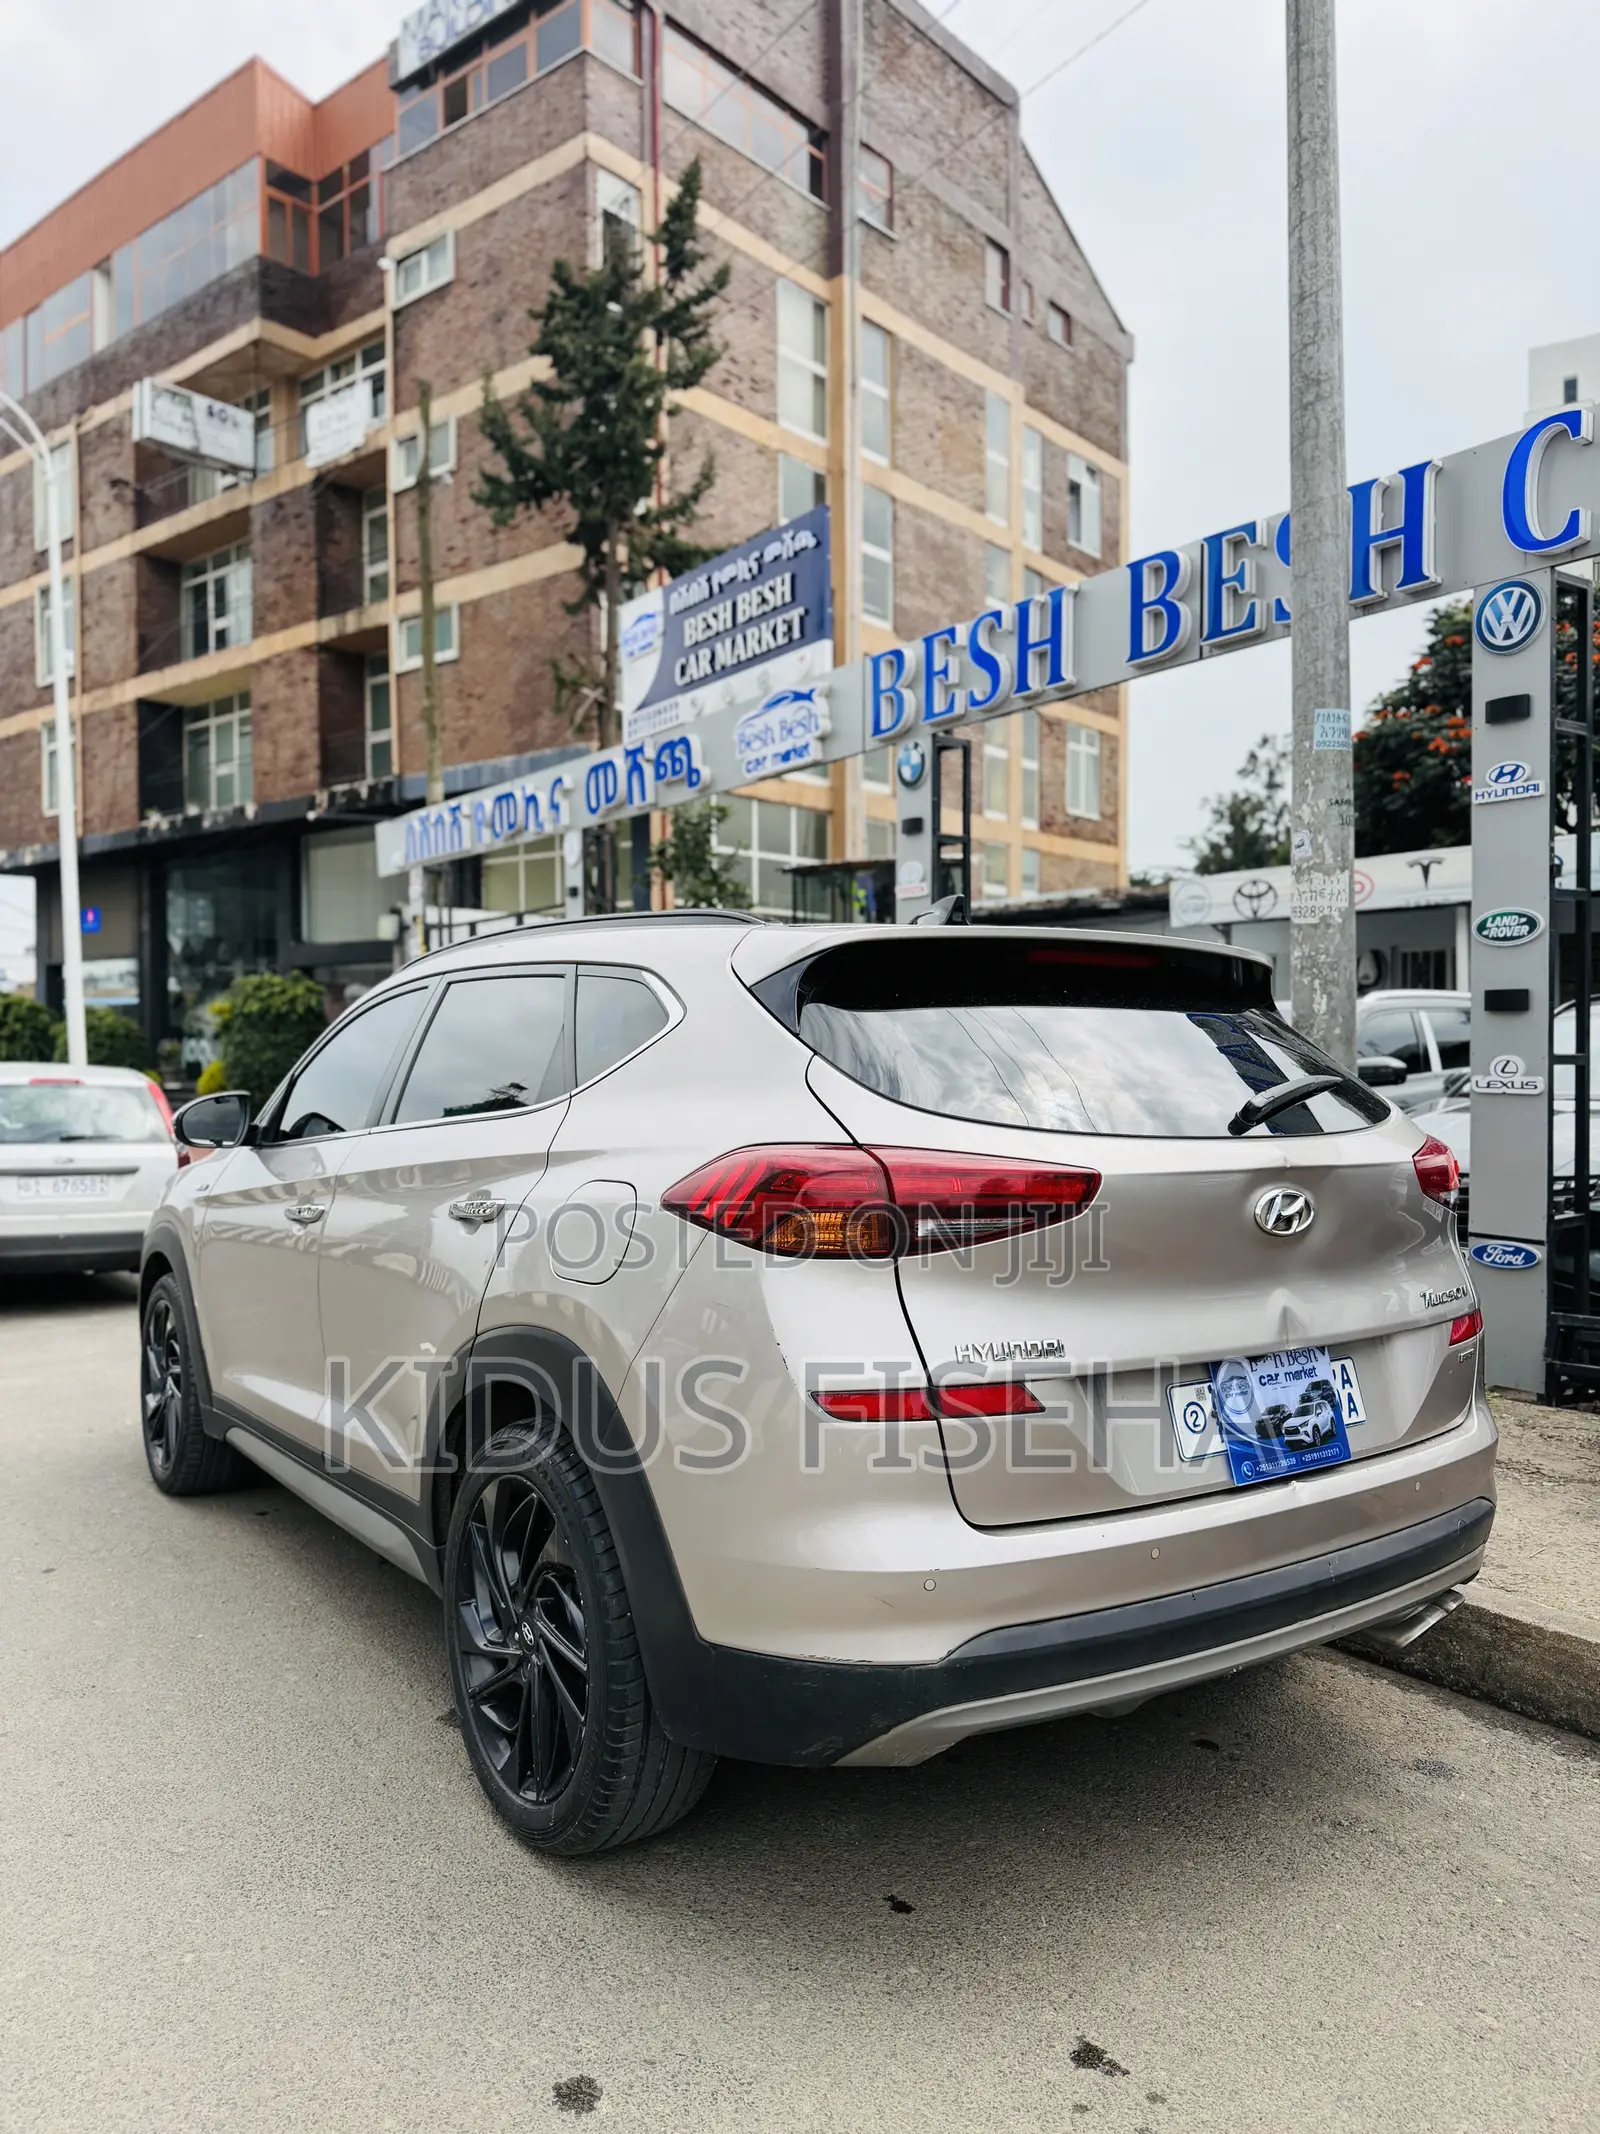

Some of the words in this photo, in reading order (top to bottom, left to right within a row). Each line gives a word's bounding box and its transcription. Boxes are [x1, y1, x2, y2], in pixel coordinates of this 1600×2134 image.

[683, 600, 735, 648] BESH
[736, 571, 794, 626] BESH
[675, 649, 714, 688] CAR
[714, 606, 807, 673] MARKET
[871, 583, 1081, 741] BESH
[737, 721, 775, 757] Besh
[779, 706, 820, 743] Besh
[1474, 782, 1540, 801] HYUNDAI
[473, 775, 565, 845] የመኪና
[1486, 915, 1519, 927] LAND
[1488, 925, 1530, 938] ROVER
[1475, 1080, 1539, 1090] LEXUS
[1482, 1244, 1526, 1265] Ford
[954, 1338, 1067, 1364] HYUNDAI
[1258, 1372, 1281, 1387] car
[1283, 1365, 1319, 1384] market
